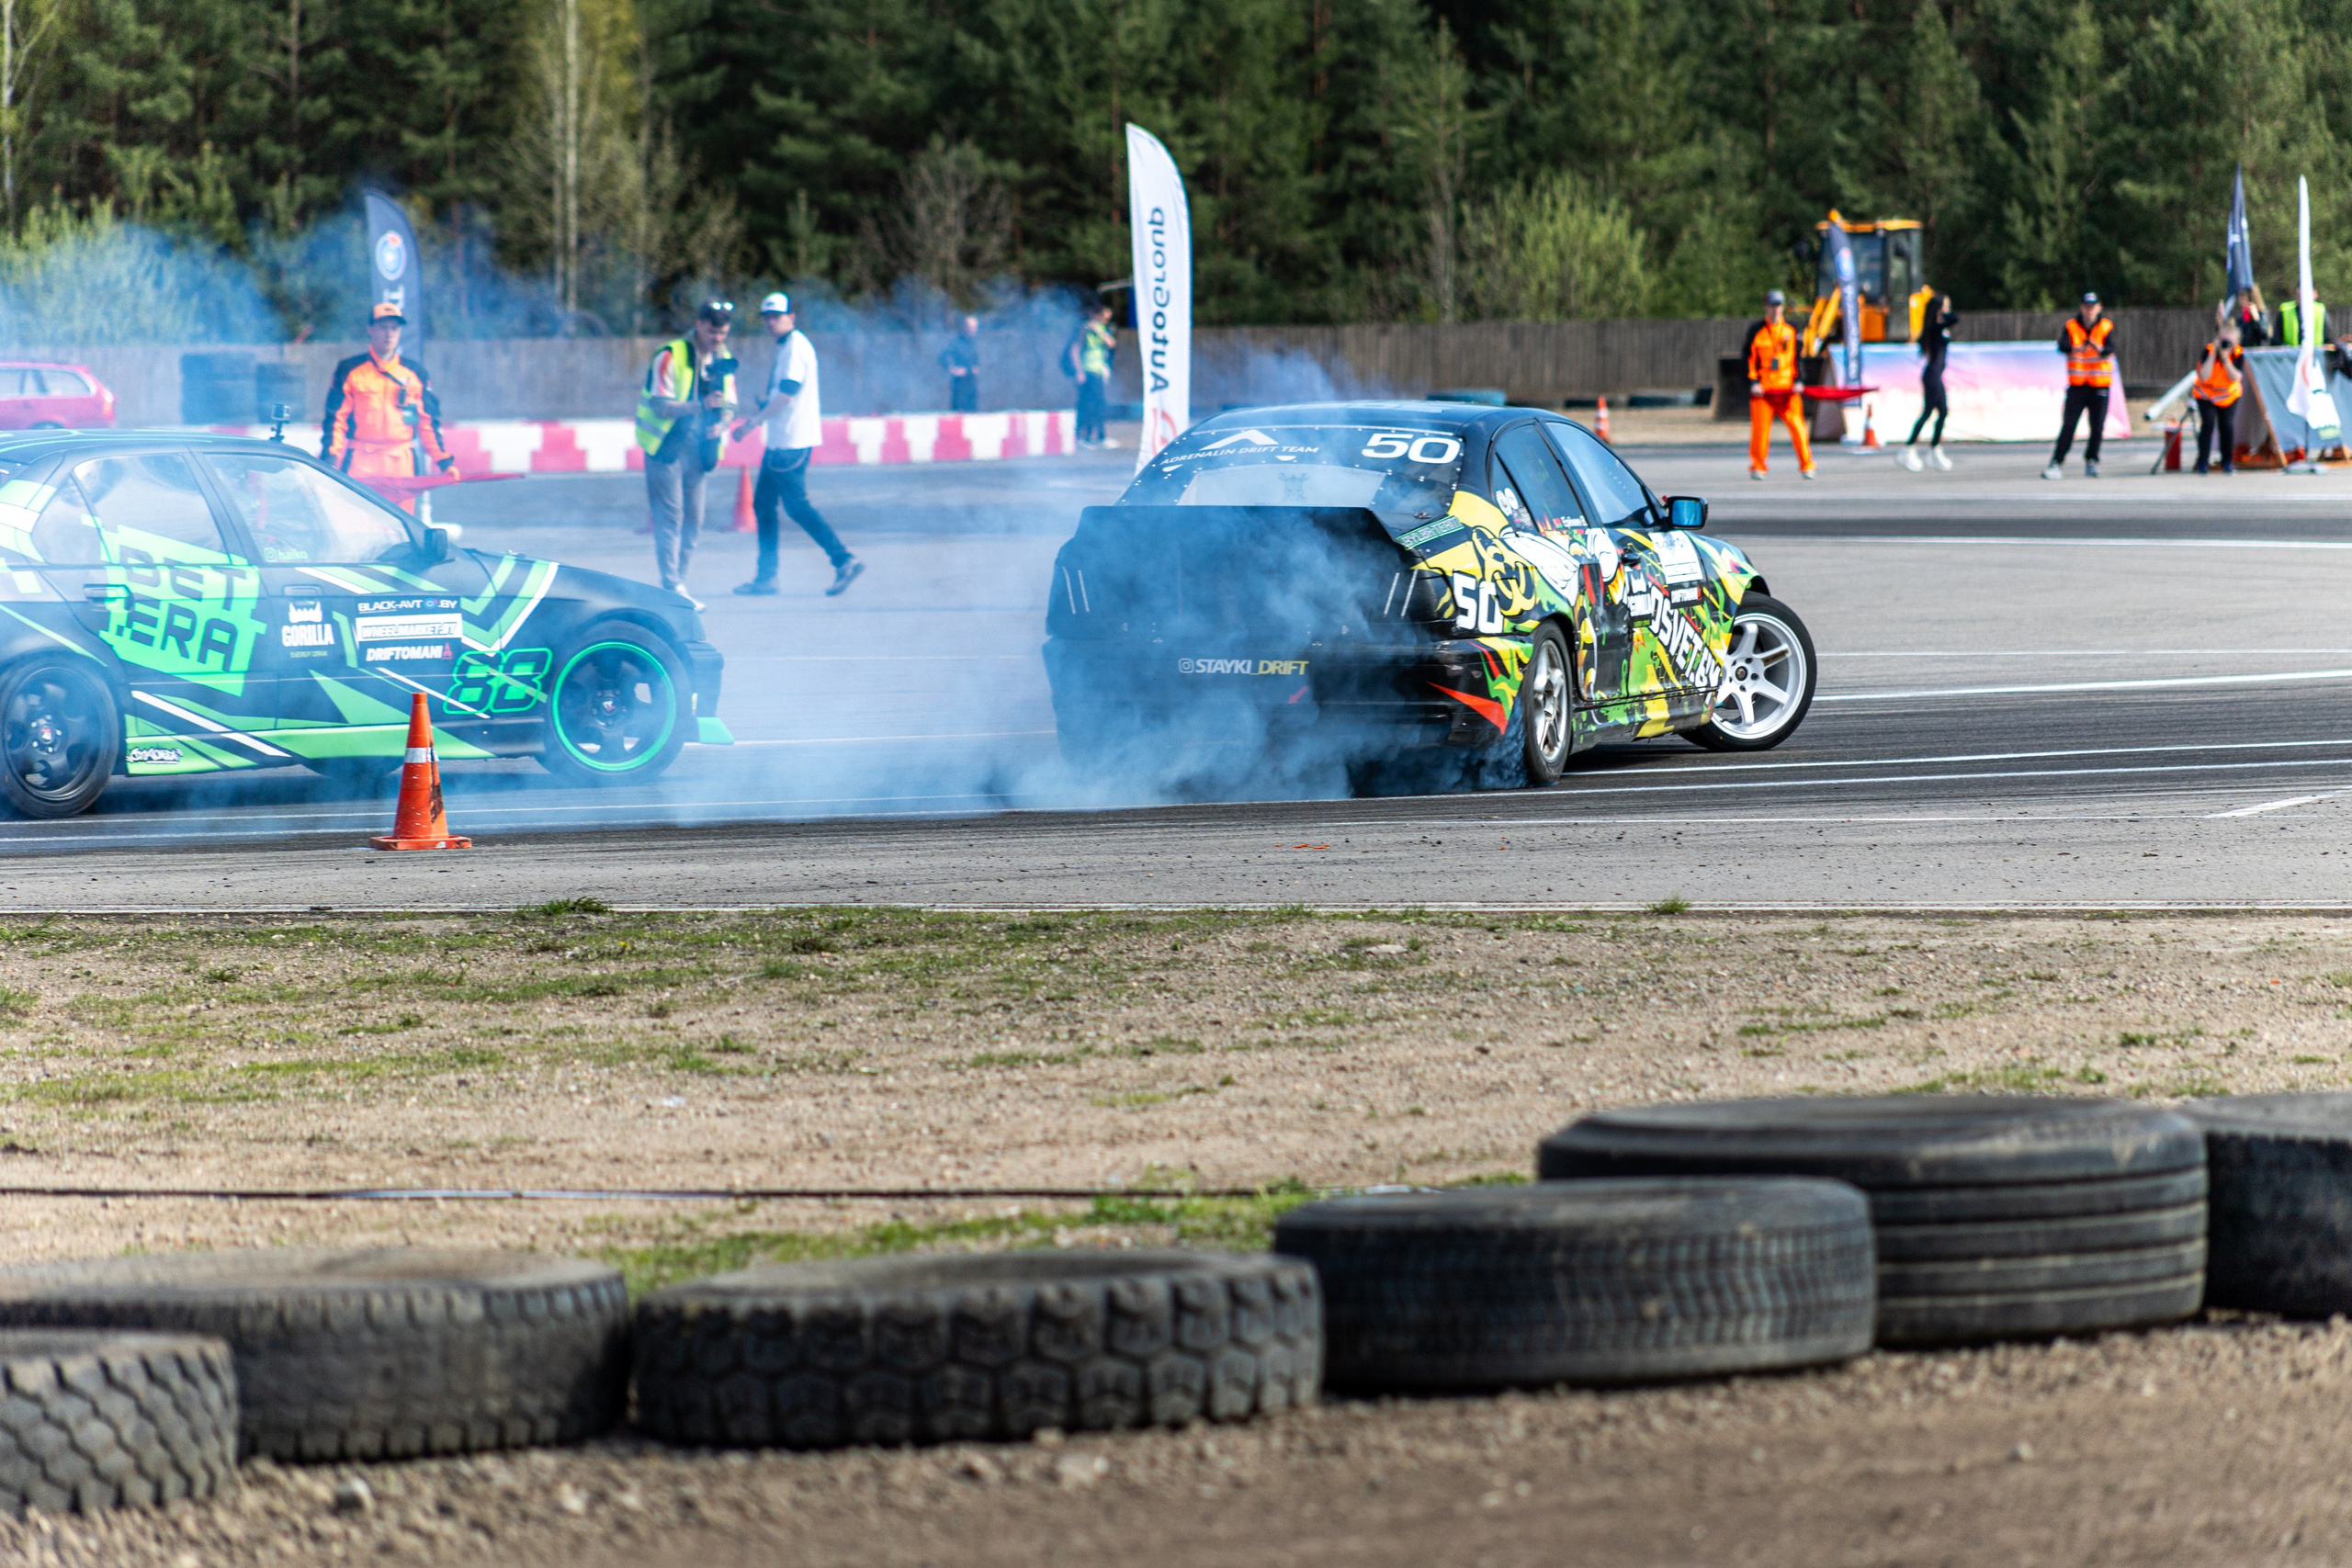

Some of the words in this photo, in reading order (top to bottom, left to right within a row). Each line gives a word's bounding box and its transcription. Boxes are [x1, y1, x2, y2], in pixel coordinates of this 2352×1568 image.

[1159, 447, 1236, 465] ADRENALIN
[1238, 446, 1280, 455] DRIFT
[1281, 445, 1320, 454] TEAM
[1362, 433, 1462, 464] 50
[1453, 571, 1504, 634] 50
[281, 624, 335, 647] GORILLA
[443, 648, 553, 715] 88
